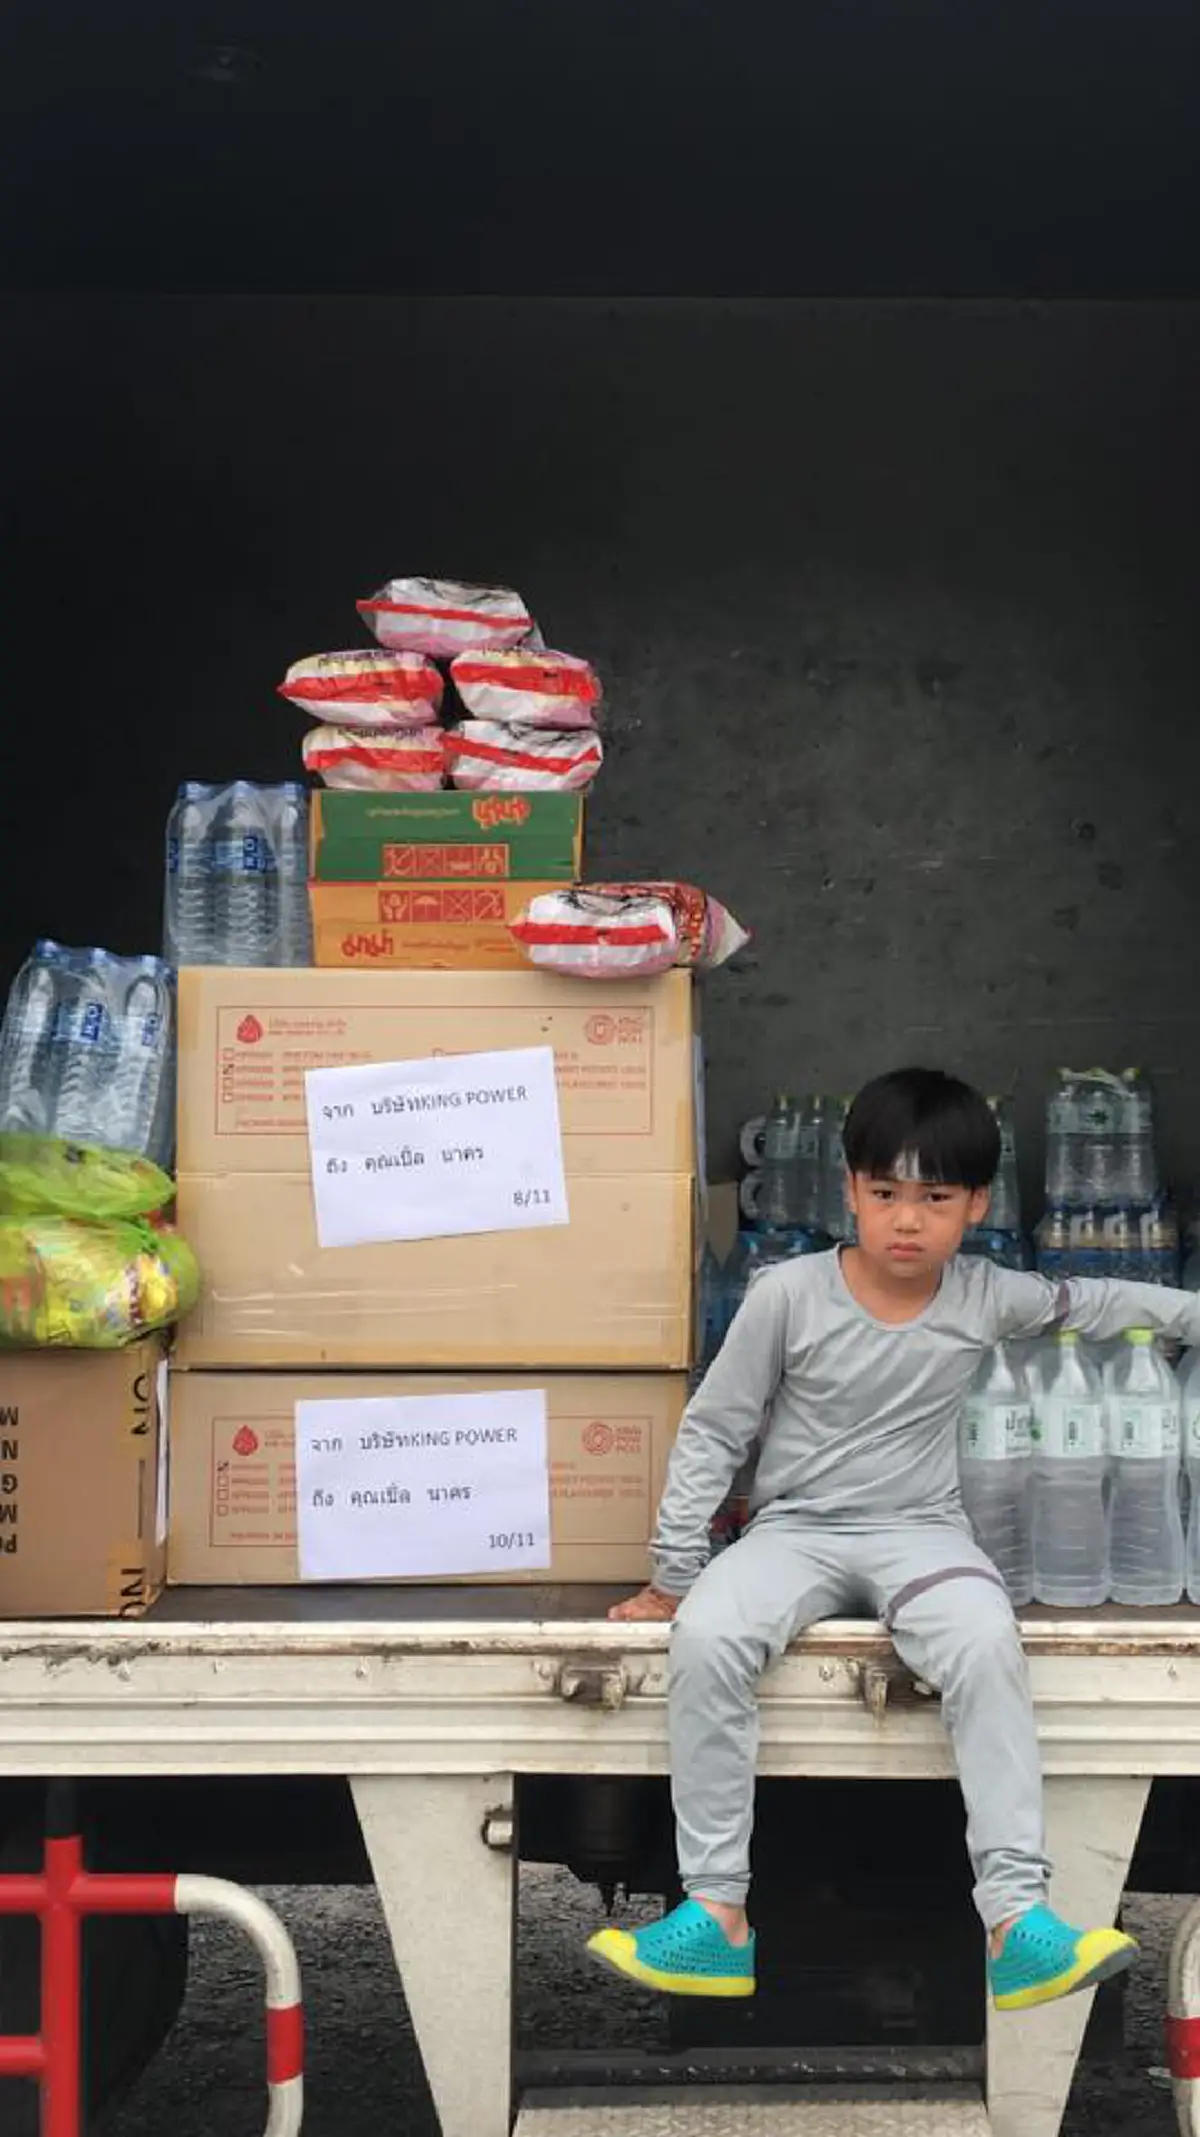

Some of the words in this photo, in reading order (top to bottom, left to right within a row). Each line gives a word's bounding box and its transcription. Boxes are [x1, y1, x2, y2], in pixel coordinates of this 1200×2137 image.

[321, 1103, 355, 1122] จาก
[465, 1084, 528, 1105] POWER
[513, 1189, 551, 1208] 8/11
[311, 1437, 343, 1454] จาก
[454, 1426, 518, 1446] POWER
[312, 1489, 335, 1508] ถึง
[426, 1486, 473, 1502] นาคร
[488, 1531, 535, 1550] 10/11
